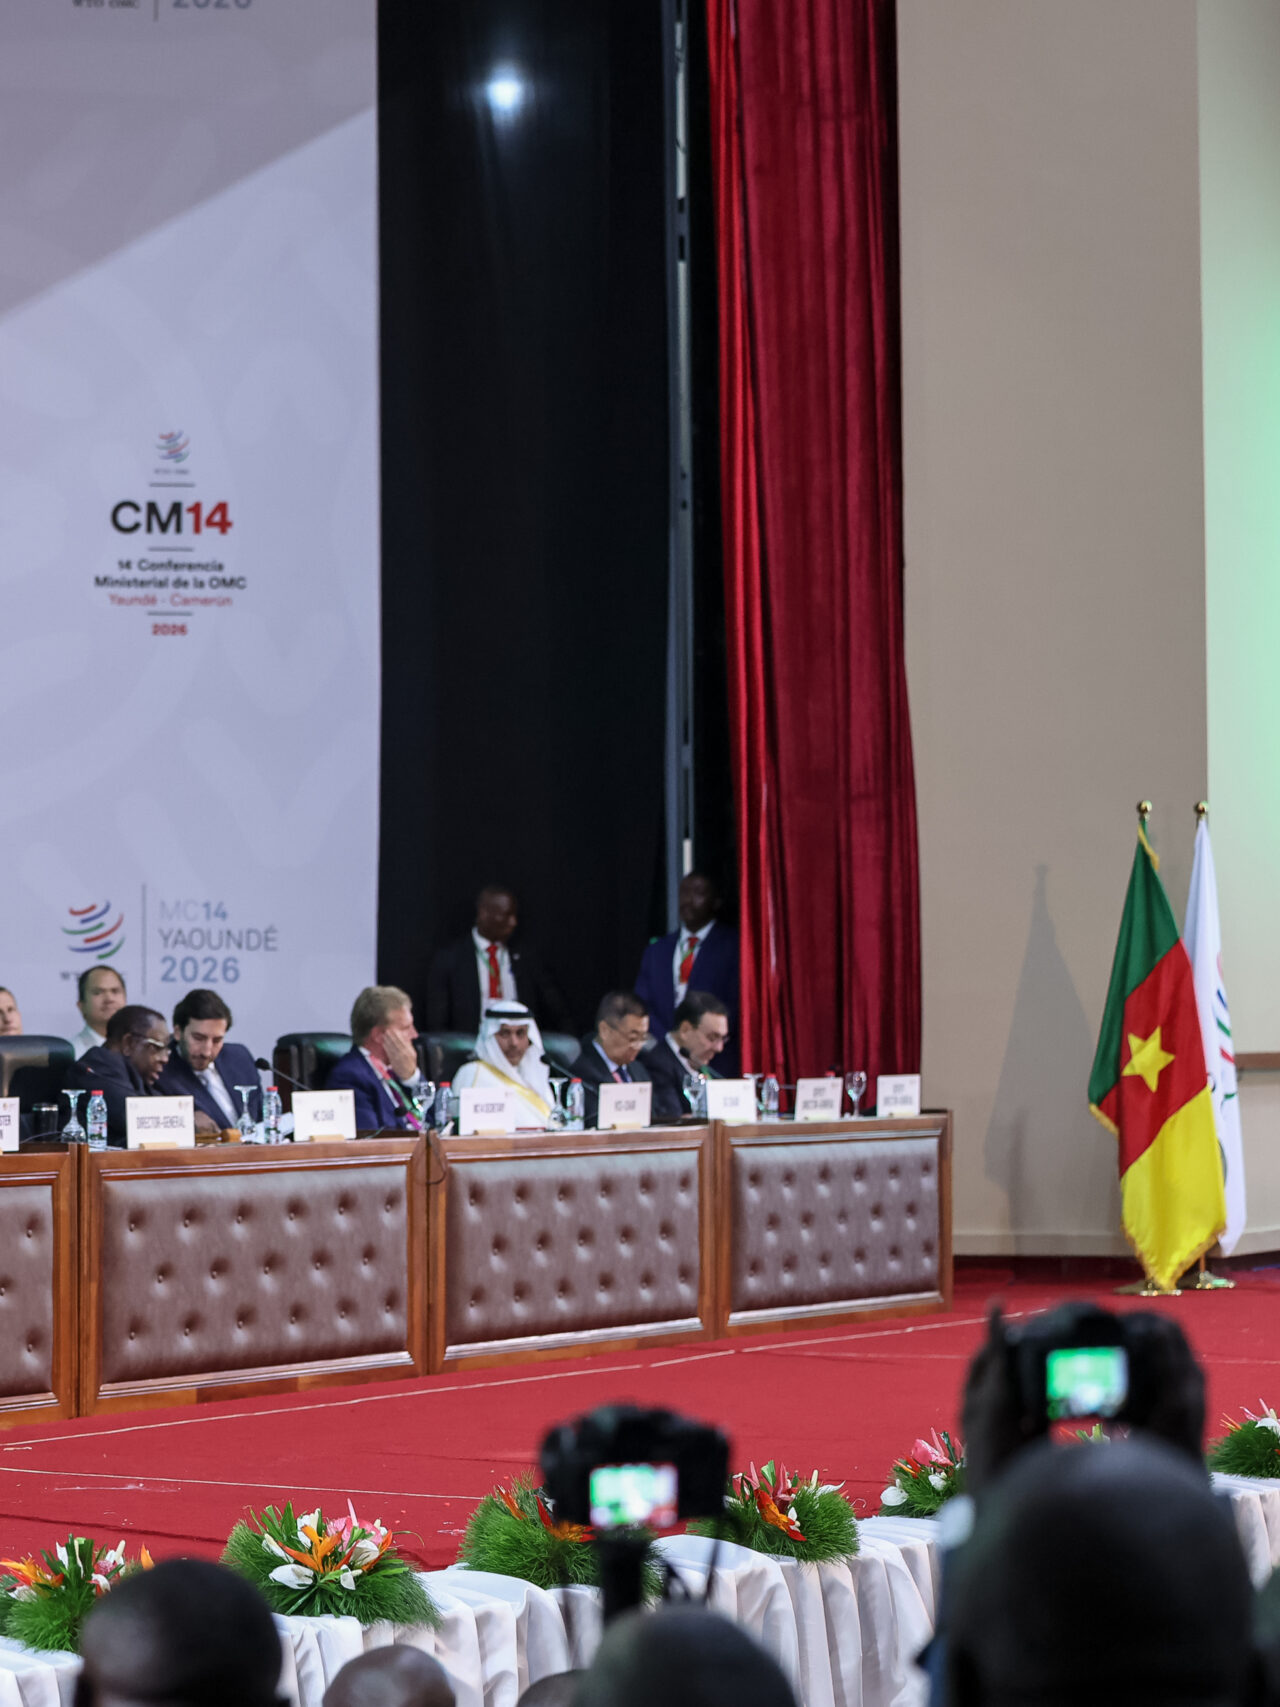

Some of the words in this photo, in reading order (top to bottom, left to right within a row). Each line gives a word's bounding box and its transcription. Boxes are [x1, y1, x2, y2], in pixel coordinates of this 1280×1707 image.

[110, 500, 233, 535] CM14
[138, 559, 224, 572] Conferencia
[94, 576, 169, 590] Ministerial
[172, 577, 189, 590] de
[193, 577, 205, 590] la
[209, 576, 247, 590] OMC
[159, 900, 227, 921] MC14
[158, 924, 278, 951] YAOUNDÉ
[160, 955, 240, 984] 2026
